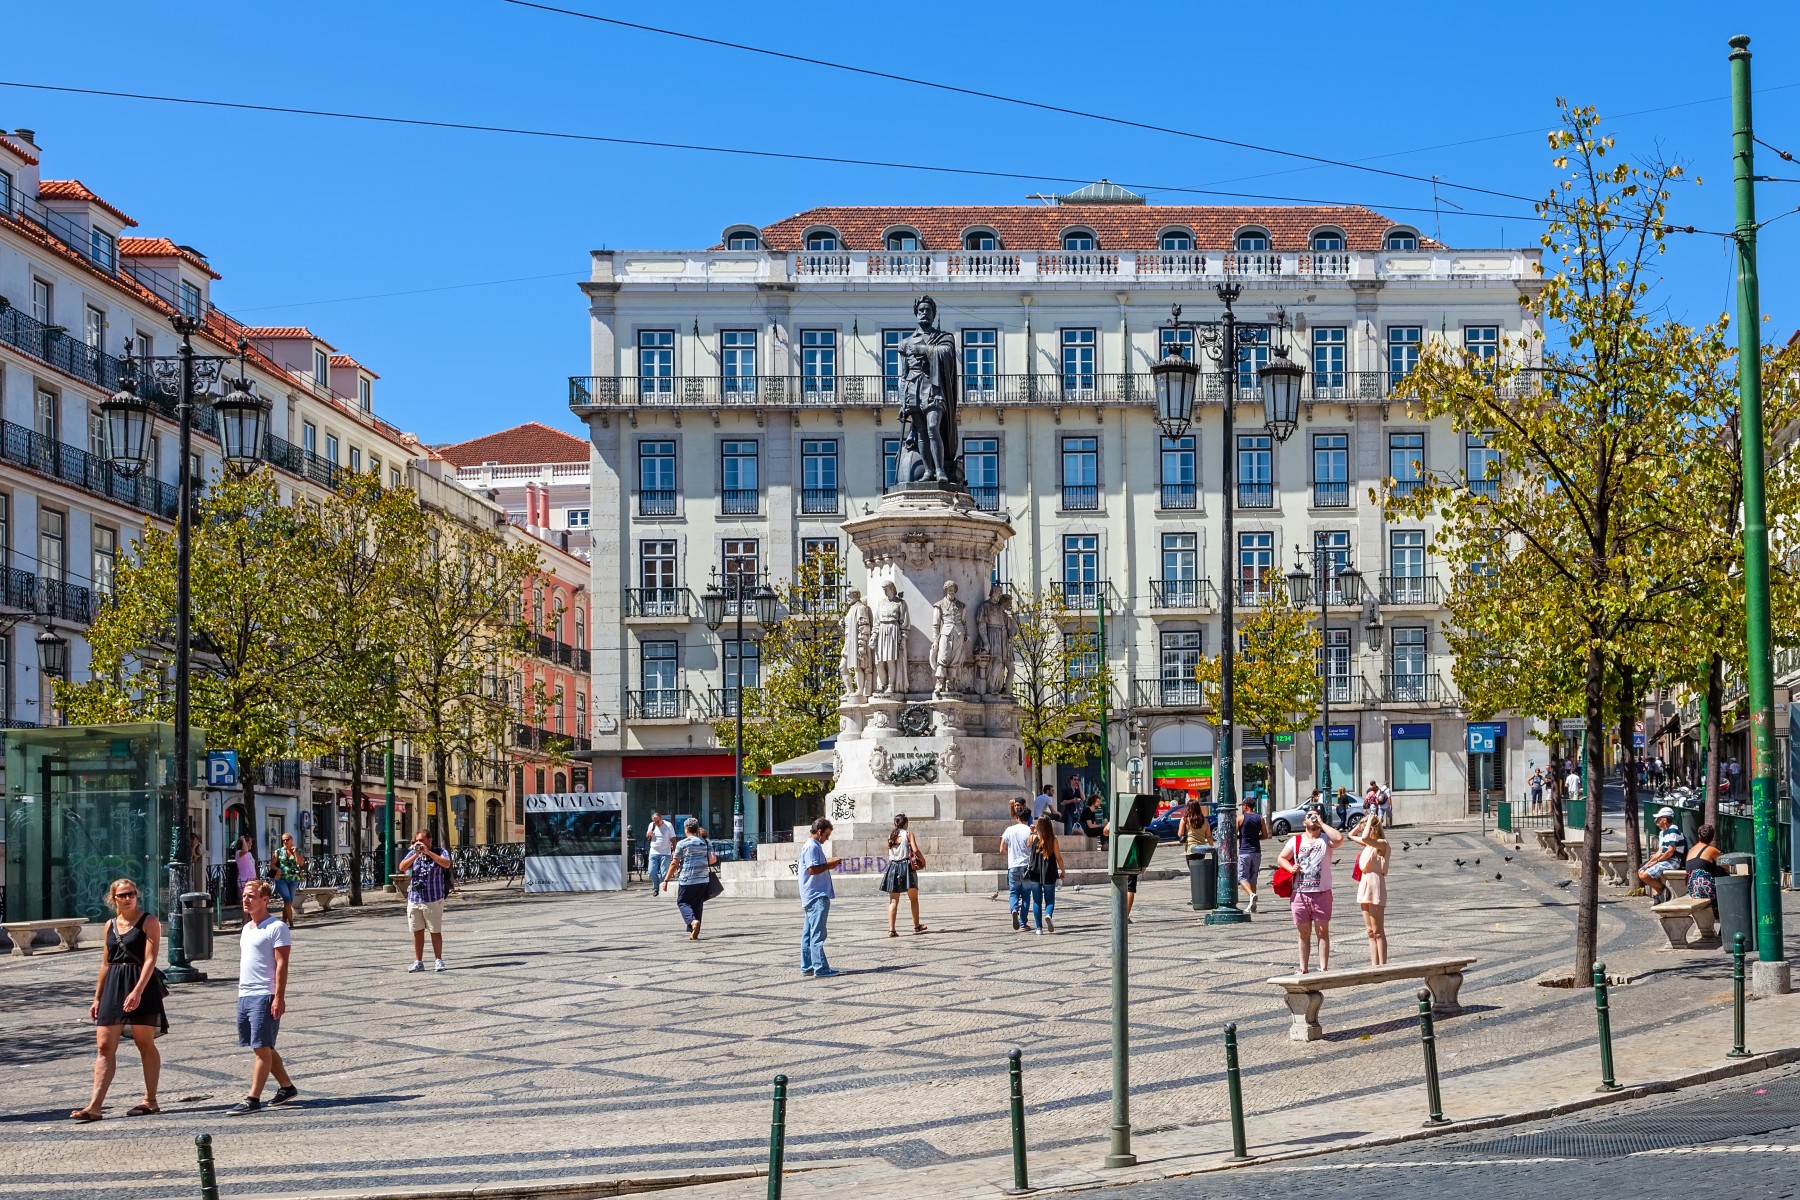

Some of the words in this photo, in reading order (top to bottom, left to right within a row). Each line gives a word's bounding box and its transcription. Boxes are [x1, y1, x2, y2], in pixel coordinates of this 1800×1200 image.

[1470, 733, 1483, 749] P
[211, 760, 230, 784] P
[526, 796, 547, 809] OS
[553, 795, 605, 808] MAIAS
